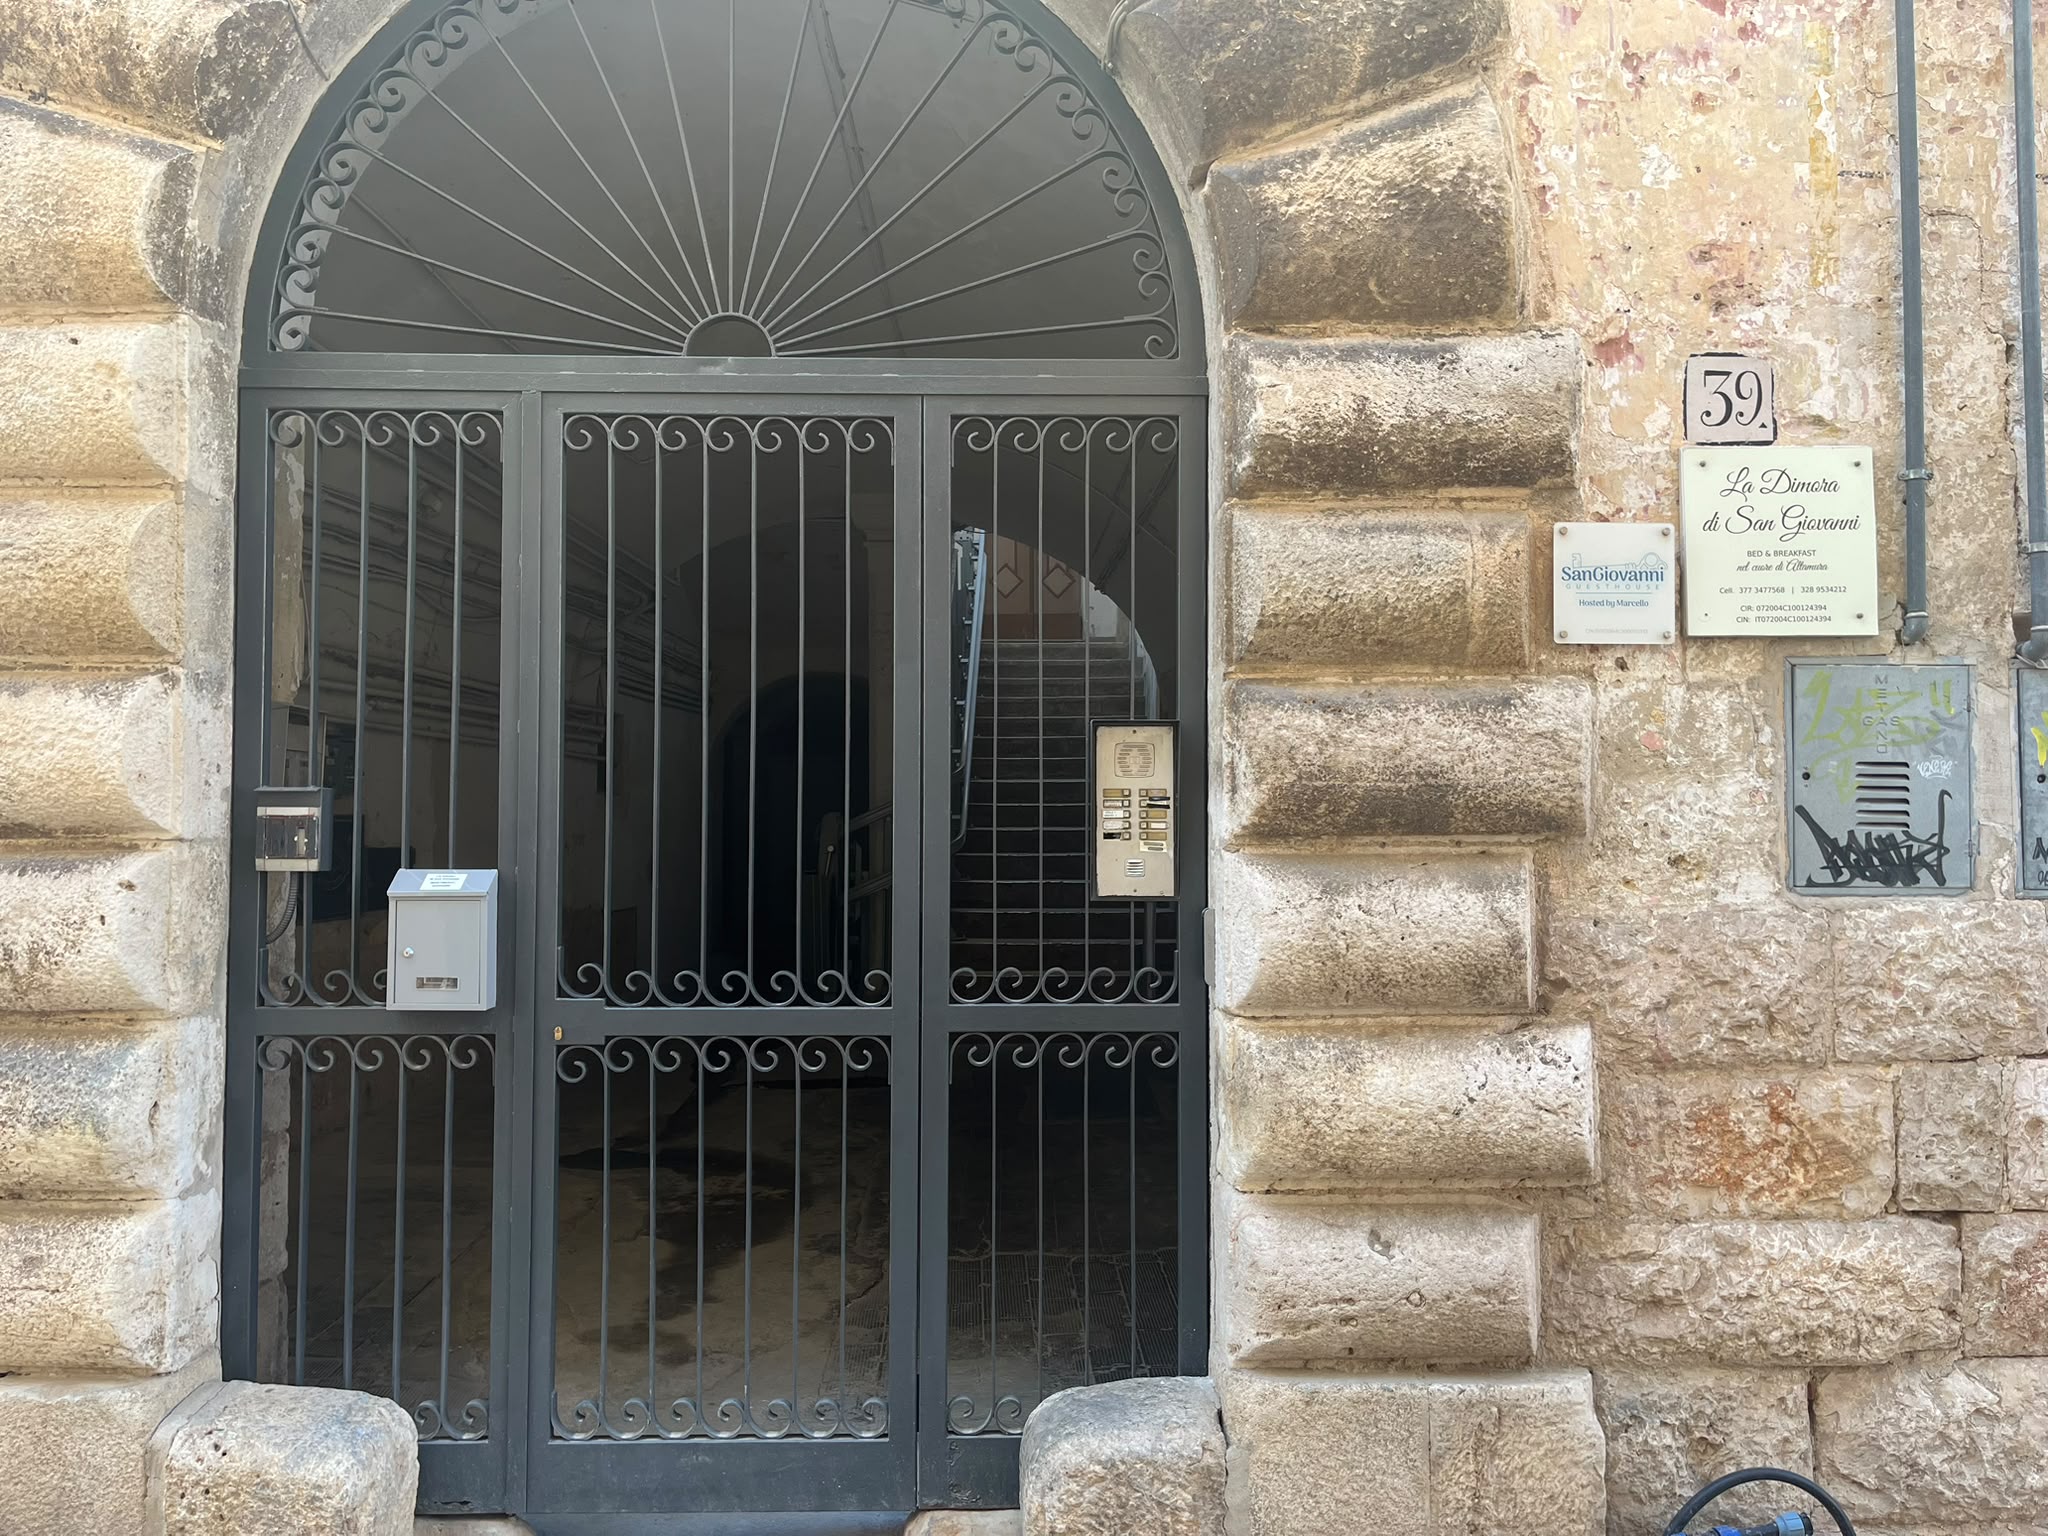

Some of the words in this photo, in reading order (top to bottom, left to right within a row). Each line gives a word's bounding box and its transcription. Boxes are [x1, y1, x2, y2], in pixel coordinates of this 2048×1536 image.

[1700, 369, 1763, 427] 39
[1719, 466, 1755, 502] La
[1759, 468, 1840, 494] Dimora
[1702, 511, 1721, 532] di
[1725, 505, 1776, 535] San
[1779, 504, 1861, 542] Giovanni
[1773, 549, 1817, 557] BREAKFAST
[1736, 561, 1751, 572] nel
[1751, 563, 1773, 571] cuore
[1774, 561, 1784, 571] di
[1785, 558, 1828, 572] Altamura
[1561, 566, 1664, 582] SanGiovanni
[1816, 585, 1847, 593] 9534212
[1578, 599, 1605, 607] Hosted
[1606, 599, 1616, 608] by
[1616, 599, 1649, 607] Marcello
[1862, 715, 1901, 727] GAS
